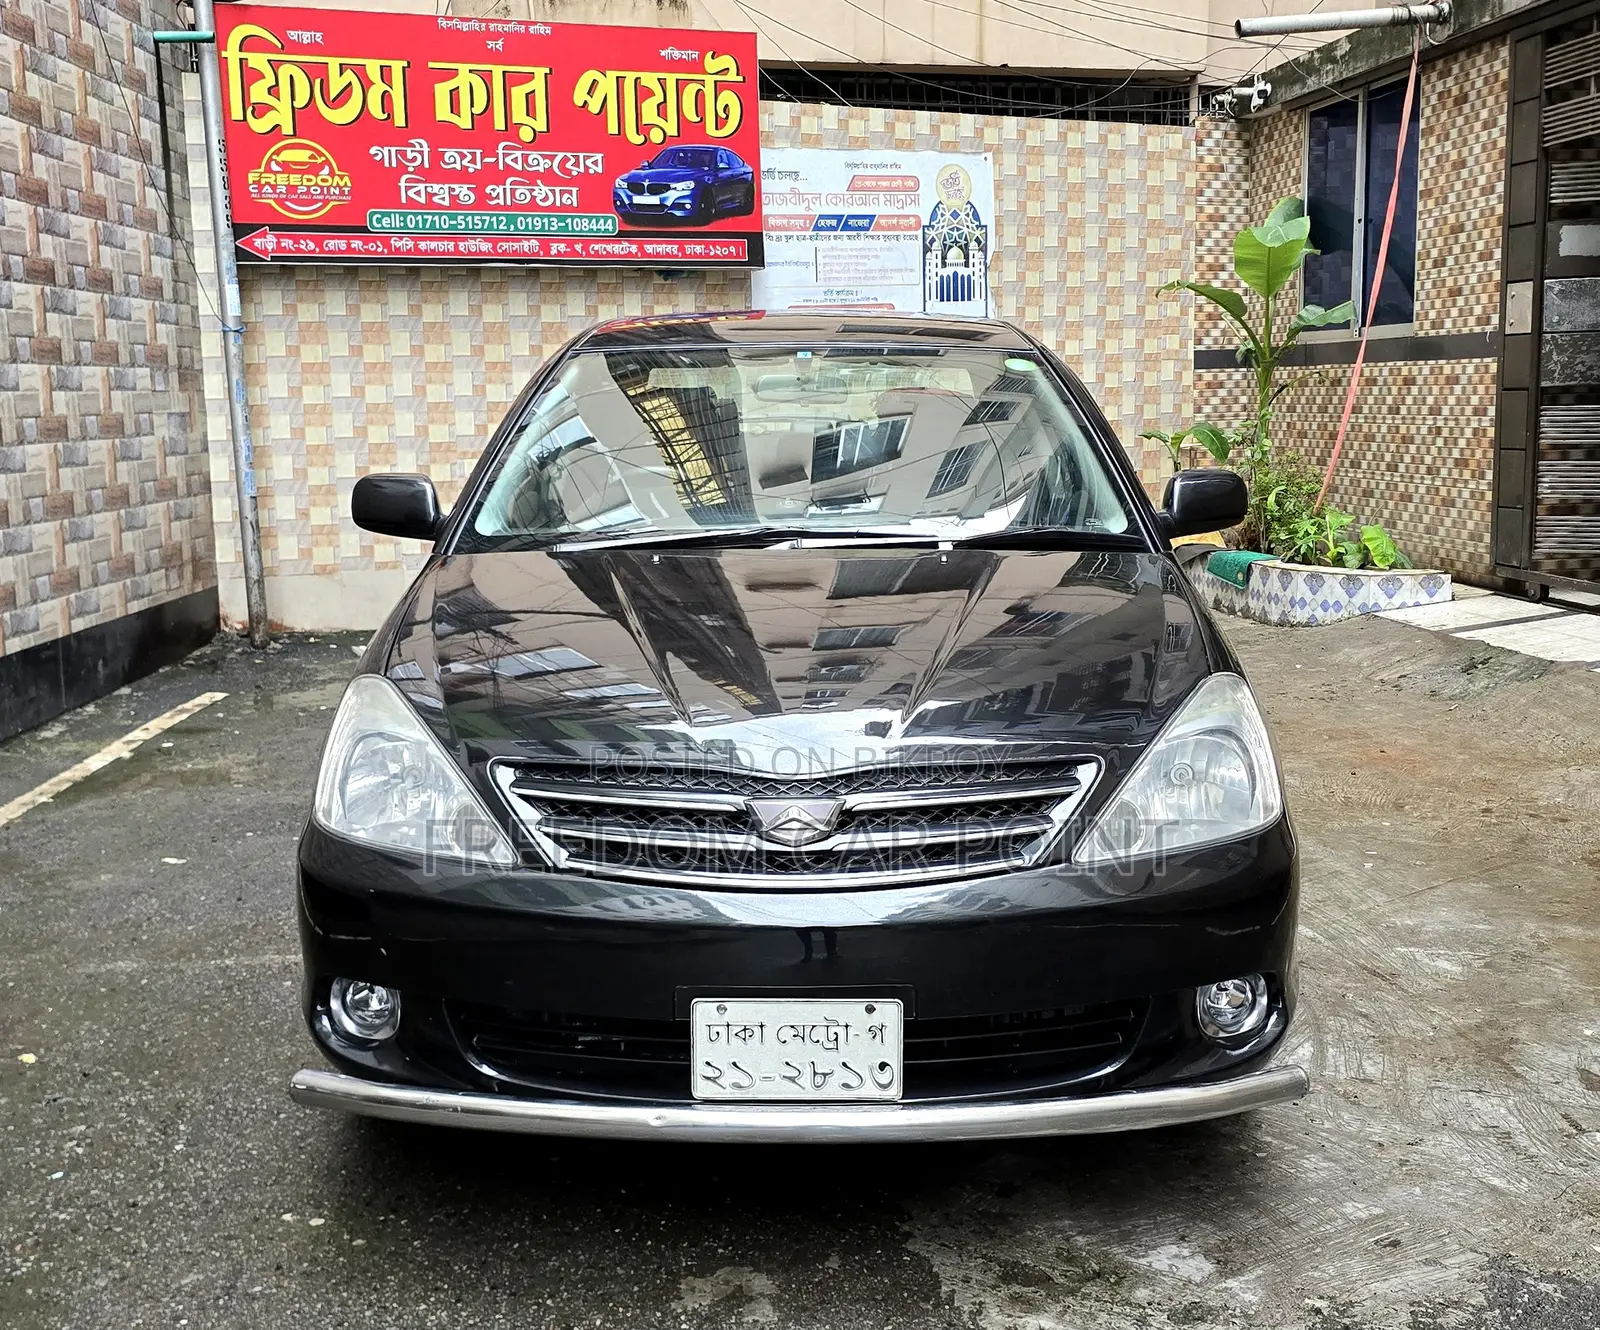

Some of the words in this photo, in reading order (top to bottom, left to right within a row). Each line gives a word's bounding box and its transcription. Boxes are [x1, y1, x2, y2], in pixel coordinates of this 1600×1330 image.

[437, 17, 486, 32] বিসমিল্লাহির
[488, 21, 526, 34] রাহমানির
[528, 23, 552, 36] রাহিম
[286, 29, 324, 45] আল্লাহ
[486, 37, 504, 52] সর্ব
[659, 46, 699, 62] শক্তিমান
[221, 23, 411, 136] ফ্রিডম
[428, 61, 552, 143] কার
[573, 50, 745, 145] পয়েন্ট
[369, 138, 430, 172] গাড়ী
[247, 172, 352, 187] FREEDOM
[761, 167, 776, 181] ভর্তি
[248, 184, 287, 194] CAR
[297, 186, 351, 195] POINT
[398, 174, 476, 207] বিশ্বস্ত
[485, 177, 579, 208] প্রতিষ্ঠান
[762, 187, 822, 212] তাজবীদুল
[825, 192, 880, 207] কোরআন
[883, 193, 920, 210] মাদ্রাসা
[517, 217, 613, 232] 01913-108444
[323, 238, 347, 251] রোড
[391, 238, 414, 253] পিসি
[417, 239, 455, 253] কালচার
[458, 238, 493, 254] হাউজিং
[497, 239, 544, 256] সোসাইটি,
[589, 242, 642, 257] শেখেরটেক,
[643, 243, 682, 258] আদাবর,
[705, 1020, 767, 1044] ঢাকা
